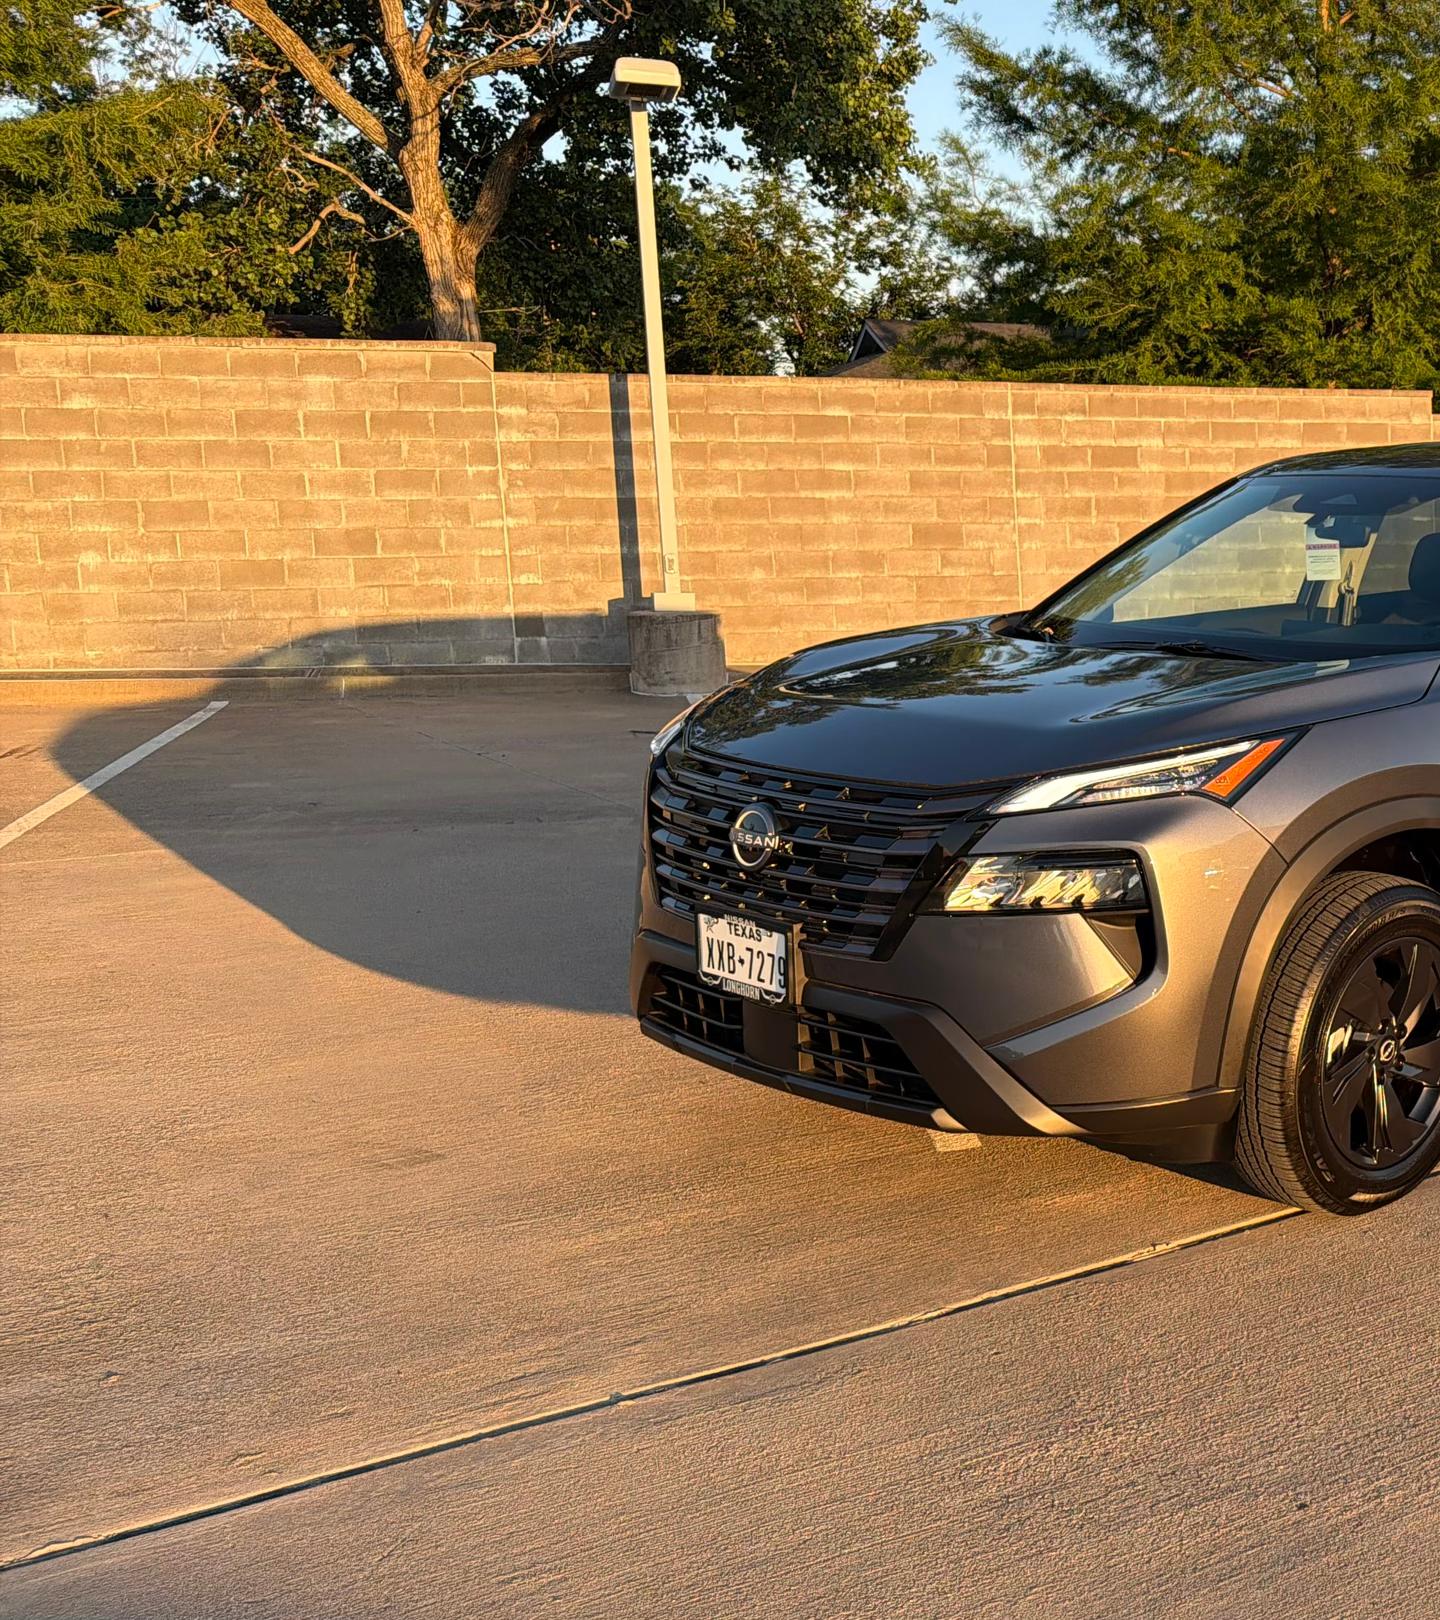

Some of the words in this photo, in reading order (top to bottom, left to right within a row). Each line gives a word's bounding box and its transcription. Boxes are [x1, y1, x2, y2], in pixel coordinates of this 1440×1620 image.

[730, 829, 776, 848] SSAN
[723, 913, 756, 927] NISSAN
[726, 921, 762, 942] TEXAS
[722, 977, 760, 1000] LONGHORN
